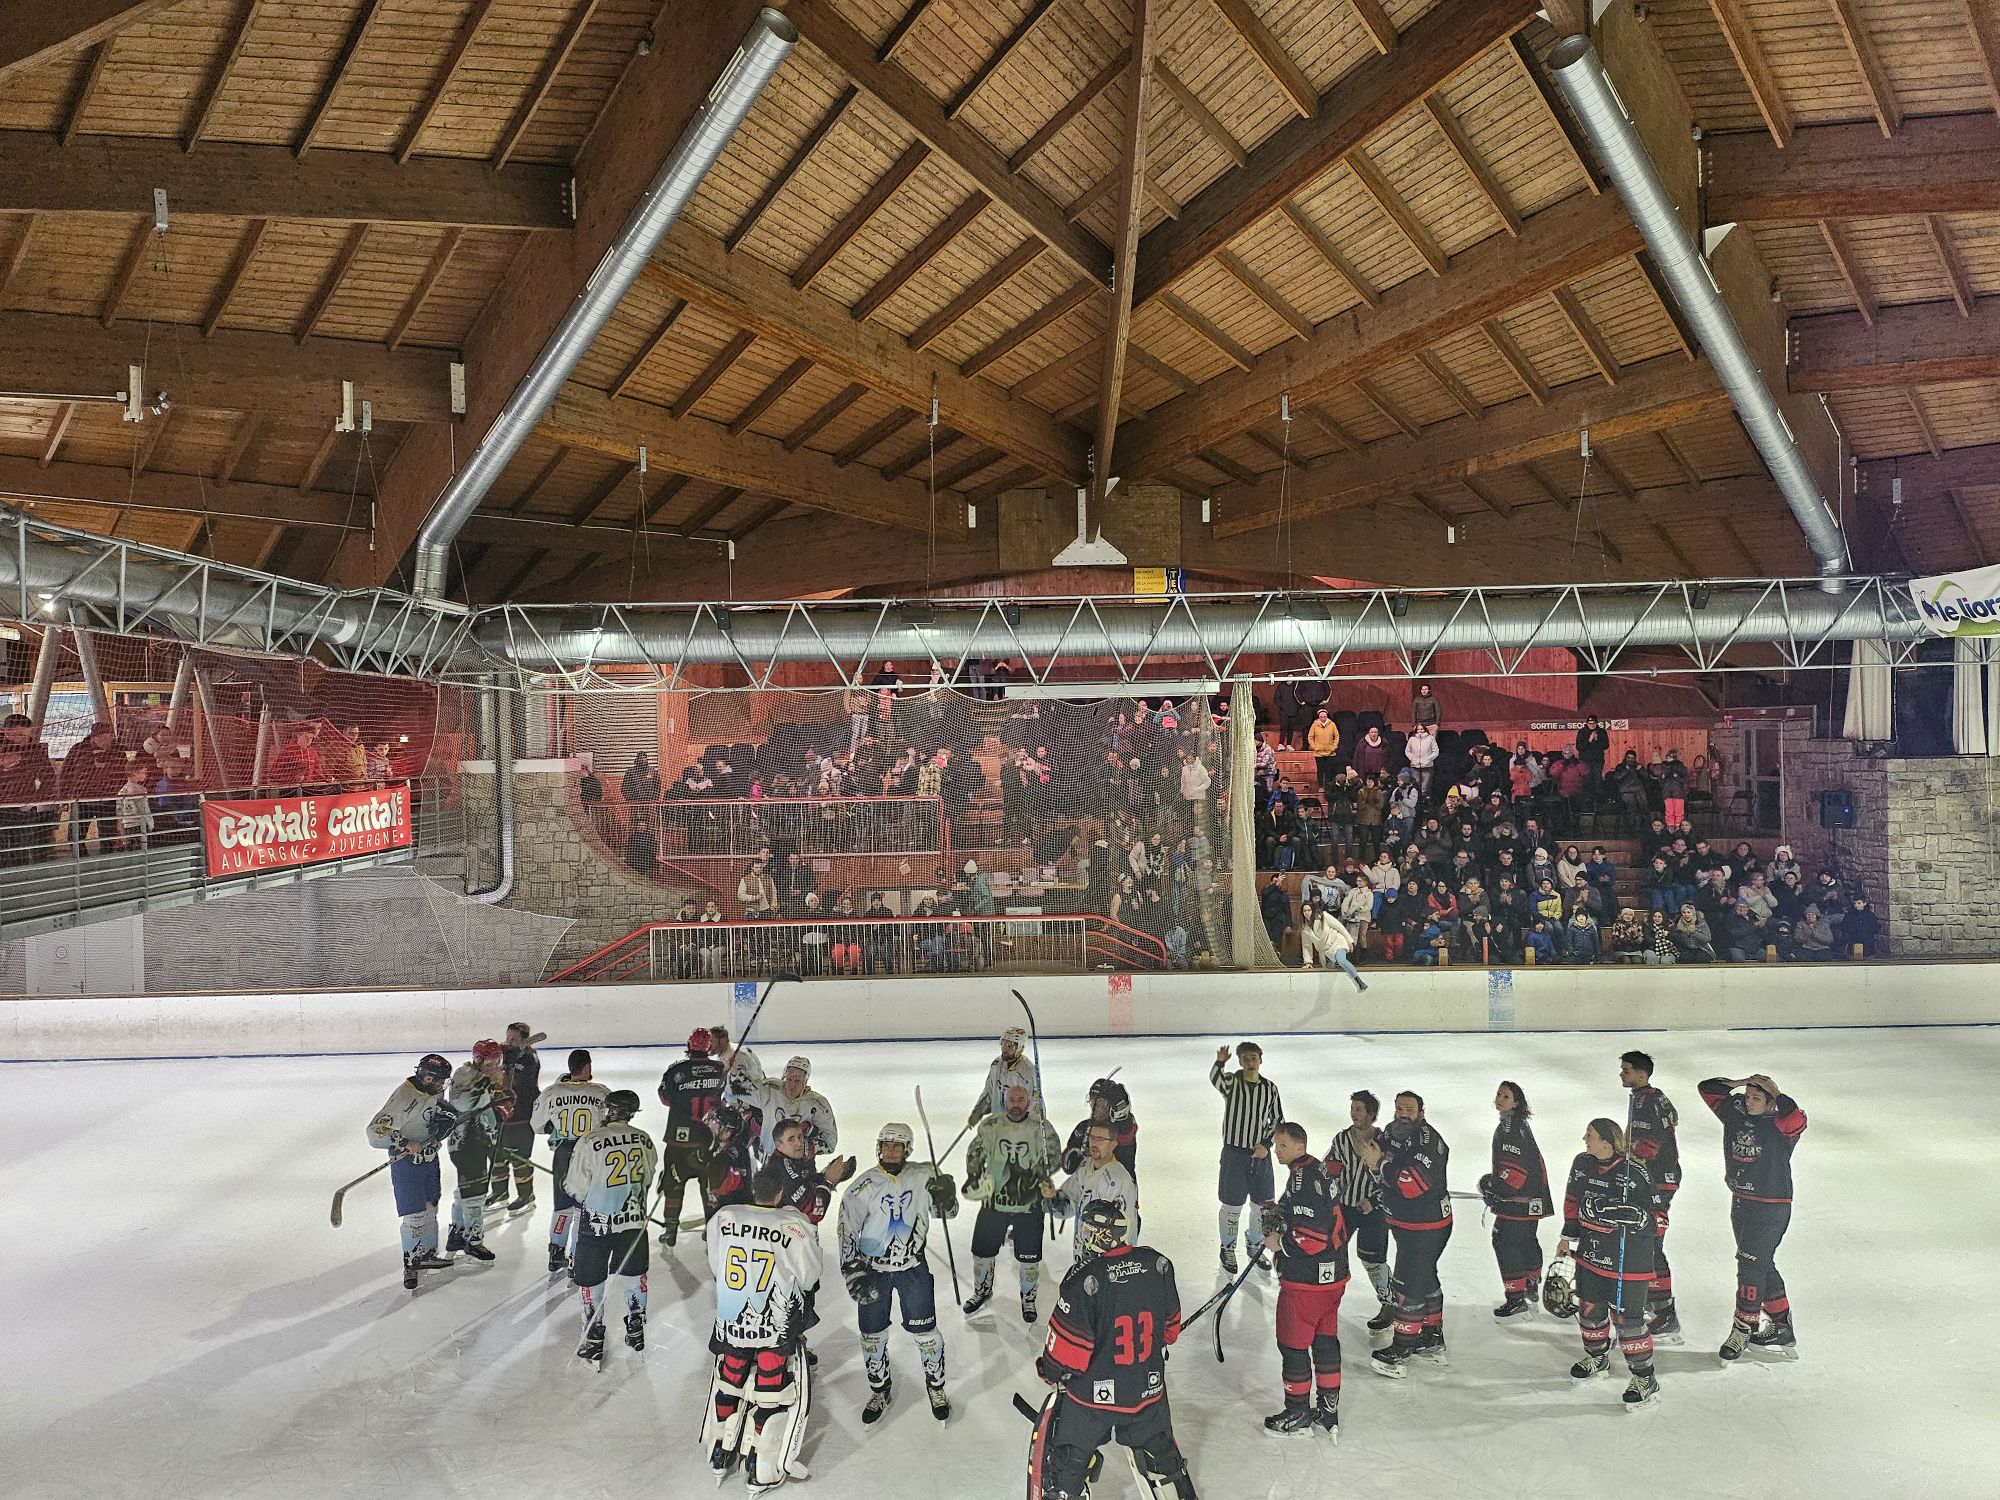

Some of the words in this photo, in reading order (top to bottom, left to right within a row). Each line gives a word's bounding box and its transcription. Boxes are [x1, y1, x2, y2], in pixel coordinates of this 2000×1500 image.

[1935, 601, 1960, 622] le
[1956, 596, 2000, 619] lior
[1531, 722, 1558, 730] SORTIE
[218, 801, 310, 849] cantal
[327, 793, 396, 836] cantal
[558, 1108, 592, 1137] 10
[605, 1148, 643, 1188] 22
[787, 1224, 806, 1240] cantal
[725, 1245, 776, 1293] 67
[727, 1323, 773, 1340] Glob
[1114, 1311, 1153, 1366] 33
